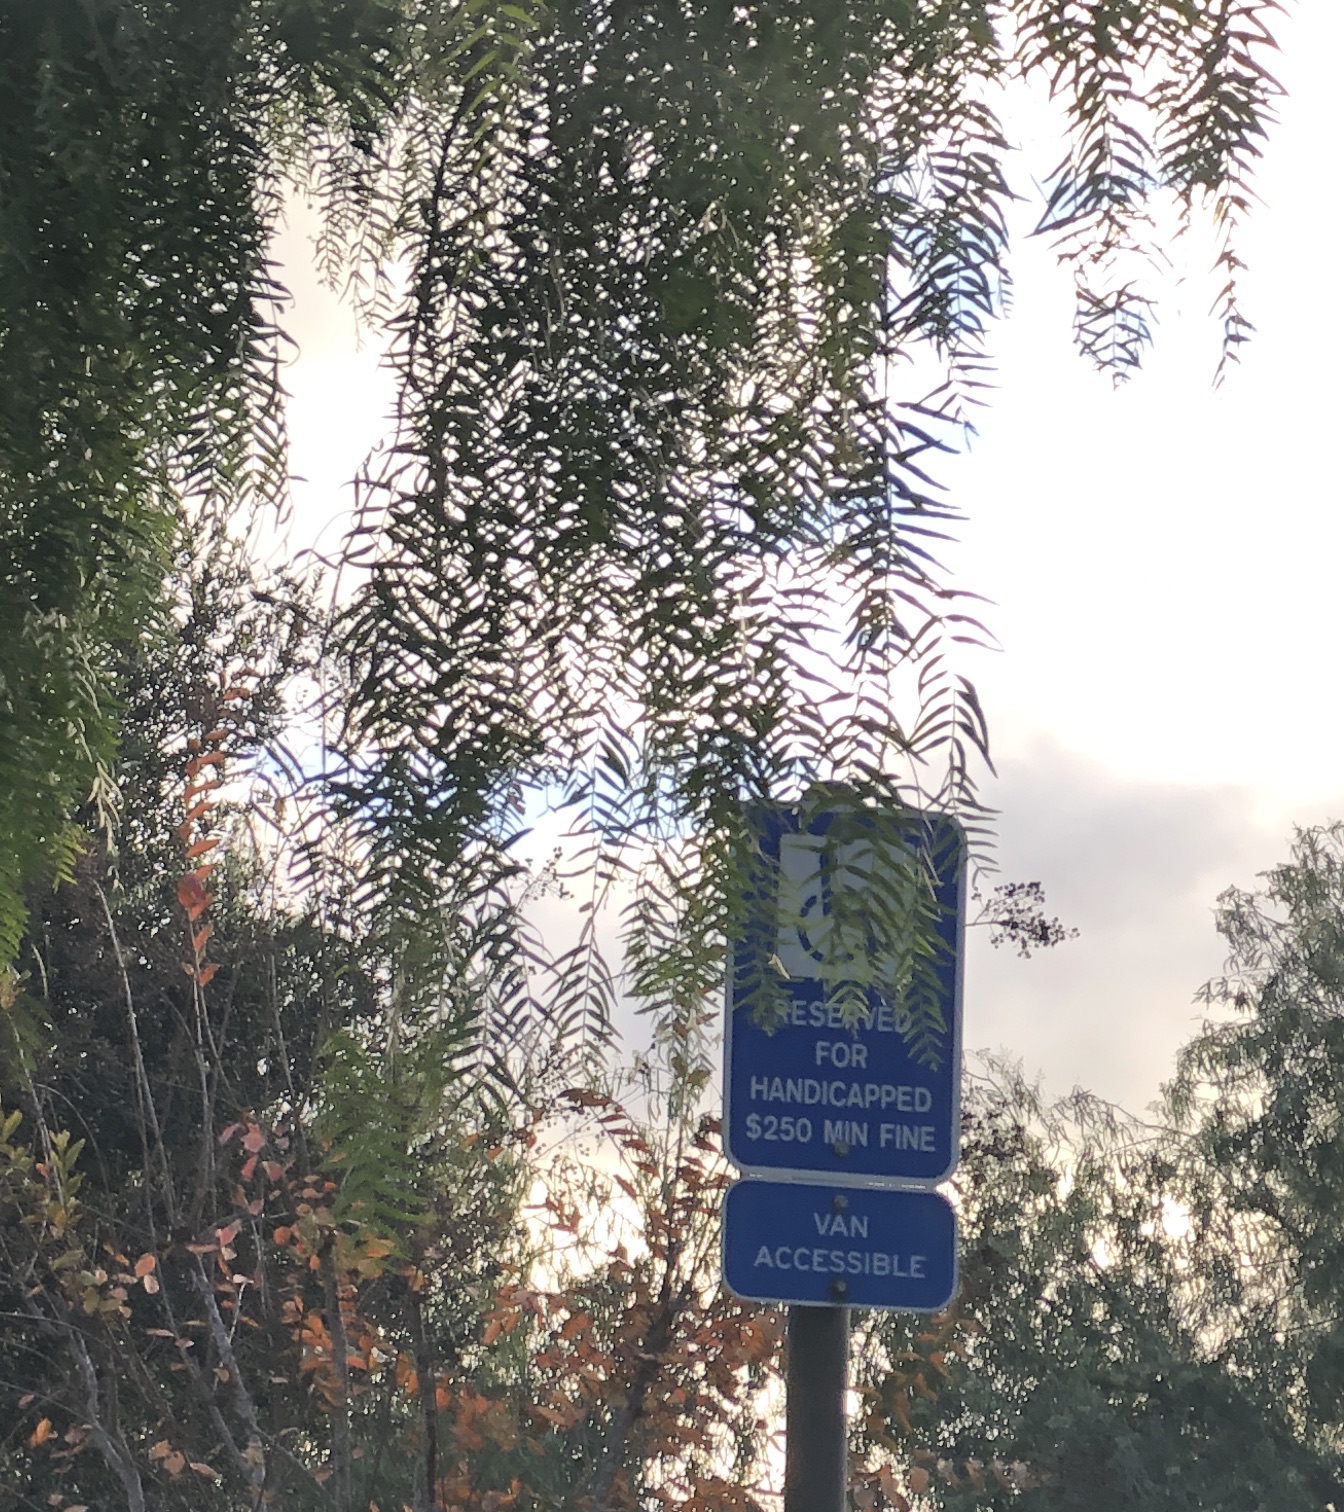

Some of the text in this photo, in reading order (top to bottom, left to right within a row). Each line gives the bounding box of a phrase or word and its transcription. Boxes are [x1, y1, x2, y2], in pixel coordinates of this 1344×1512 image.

[815, 1041, 868, 1069] FOR
[750, 1075, 932, 1113] HANDICAPPED
[745, 1113, 936, 1153] $250 MIN FINE
[813, 1212, 869, 1239] VAN
[753, 1245, 927, 1279] ACCESSIBLE
